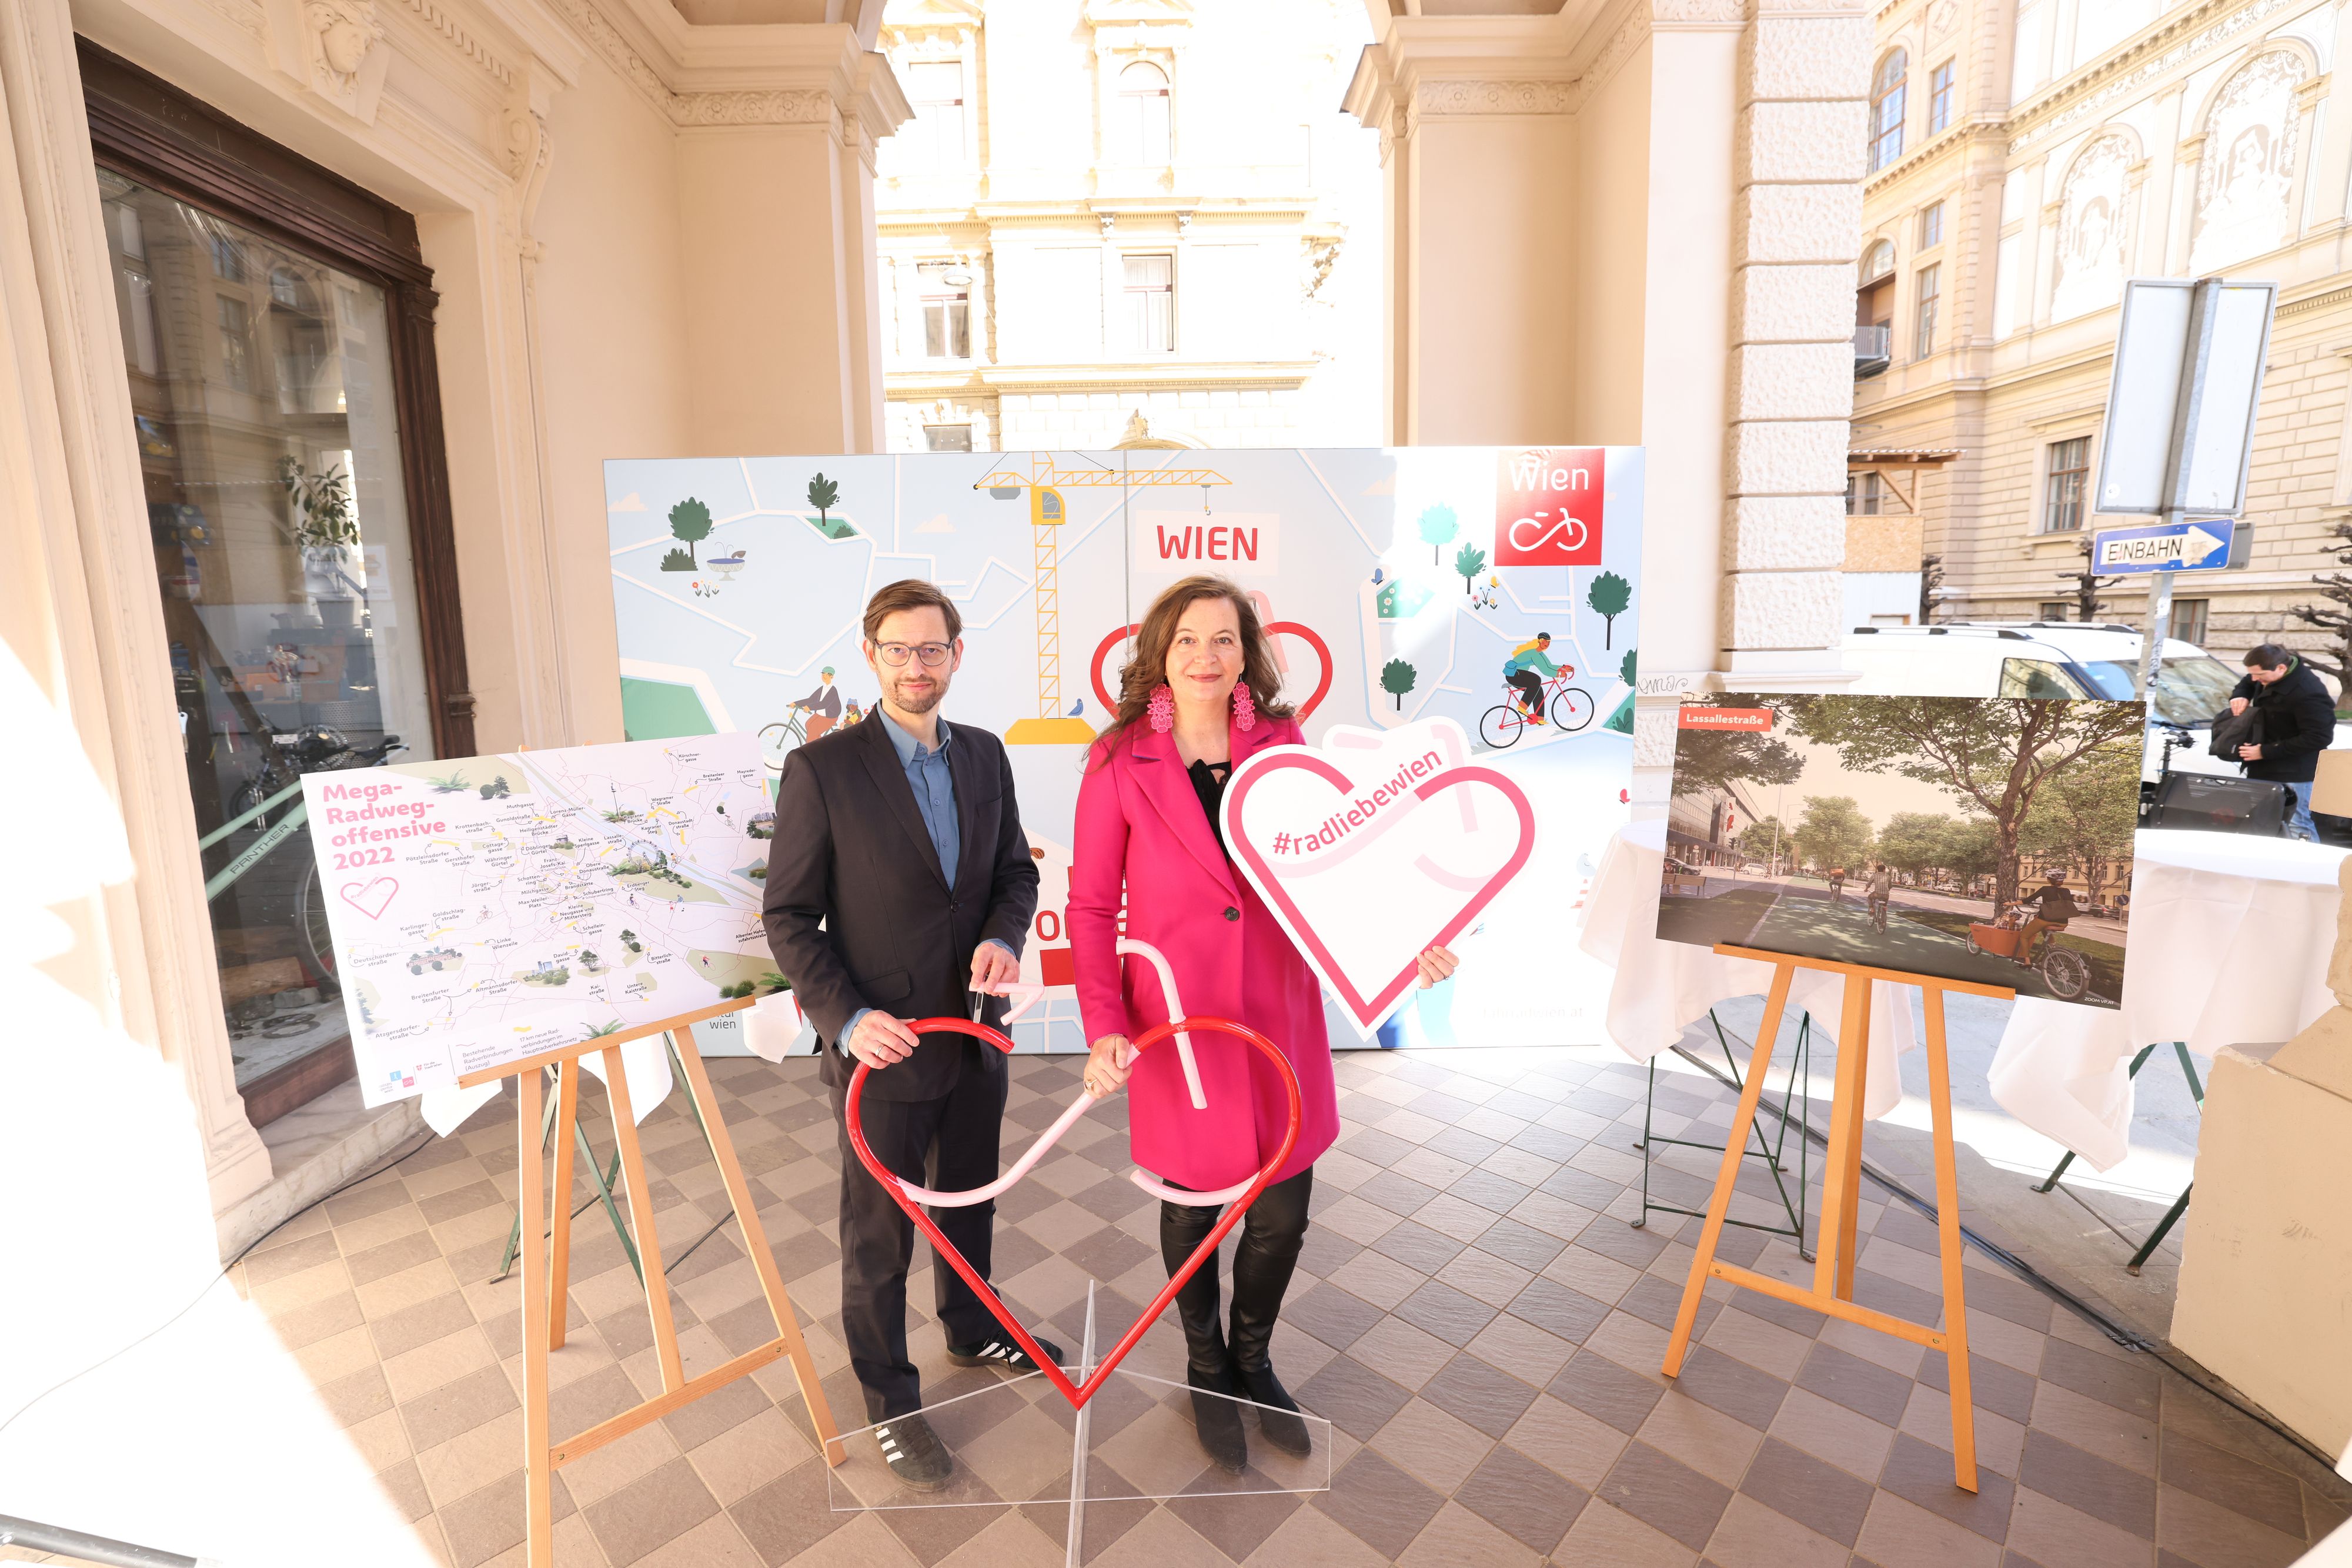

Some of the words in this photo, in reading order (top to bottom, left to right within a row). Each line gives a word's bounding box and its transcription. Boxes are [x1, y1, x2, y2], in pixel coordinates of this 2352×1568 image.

[1509, 460, 1589, 491] Wien
[1157, 525, 1258, 561] WIEN
[2109, 539, 2182, 561] EINBAHN
[1686, 714, 1763, 724] Lassallestraße
[323, 784, 402, 802] Mega-
[1272, 750, 1443, 855] #radliebewien
[326, 802, 434, 824] Radweg-
[496, 814, 531, 823] Gunoldstraße
[455, 821, 491, 830] Krottenbach-
[519, 824, 558, 833] Heiligenstädter
[332, 820, 446, 847] offensive
[230, 824, 289, 874] PANTHER
[333, 847, 395, 870] 2022
[406, 851, 449, 862] Pötzleinsdorfer
[445, 854, 475, 863] Gersthofer
[485, 855, 512, 863] Währinger
[579, 865, 609, 874] Donaustraße
[521, 887, 549, 895] Milchgasse
[565, 882, 593, 890] Brandstätte
[519, 897, 549, 905] Max-Weiler-
[432, 908, 466, 917] Goldschlag-
[560, 908, 583, 917] Neugasse
[564, 912, 592, 921] Mittersteig
[441, 914, 460, 922] straße
[400, 922, 429, 931] Karlinger-
[583, 923, 606, 931] Schellein-
[739, 934, 766, 942] zufahrtsstraße
[492, 941, 518, 950] Wienzeile
[354, 951, 399, 964] Deutschorden-
[651, 952, 673, 961] Bitterlich-
[476, 979, 519, 992] Altmannsdorfer
[625, 985, 647, 995] Kaistraße
[411, 988, 449, 1001] Breitenfurter
[489, 987, 507, 995] Straße
[422, 995, 441, 1004] Straße
[710, 1019, 736, 1029] wien
[375, 1025, 420, 1039] Atzgersdorfer-
[389, 1032, 409, 1041] straße
[521, 1036, 556, 1049] verbindungen
[522, 1037, 577, 1055] Hauptradverkehrsnetz
[462, 1045, 495, 1058] Bestehende
[464, 1048, 513, 1065] Radverbindungen
[465, 1061, 490, 1071] (Auszug)
